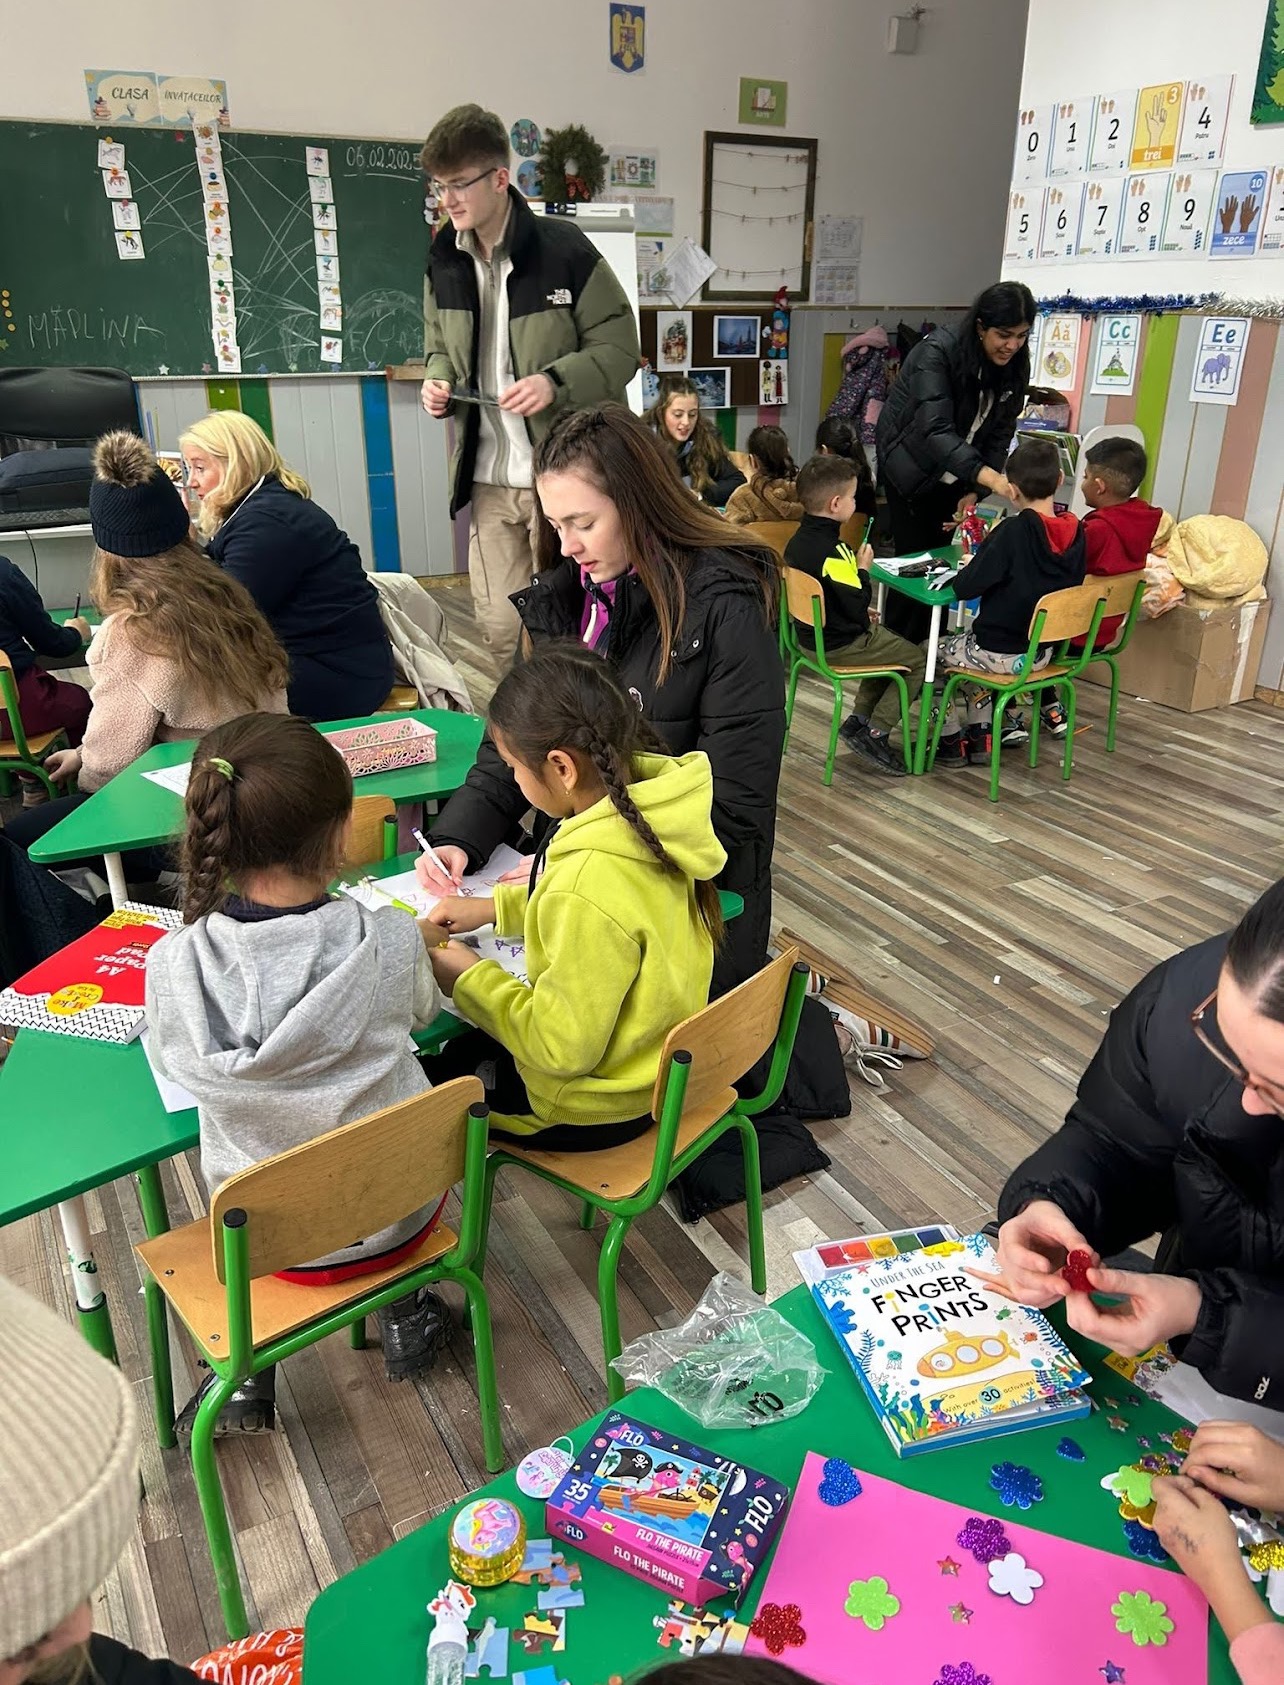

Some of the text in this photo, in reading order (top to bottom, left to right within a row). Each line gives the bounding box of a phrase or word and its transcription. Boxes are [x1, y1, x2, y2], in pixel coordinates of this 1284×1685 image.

[112, 87, 149, 100] CLASA
[1169, 87, 1178, 103] 3
[1198, 106, 1211, 129] 4
[1068, 122, 1077, 143] 1
[1108, 118, 1120, 140] 2
[1028, 132, 1039, 152] 0
[346, 144, 423, 170] 06.02.2025
[1143, 147, 1162, 160] trei
[1251, 178, 1263, 188] 10
[1057, 209, 1067, 229] 6
[1098, 205, 1108, 226] 7
[1138, 201, 1150, 223] 8
[1184, 199, 1196, 221] 9
[1019, 214, 1029, 233] 5
[1223, 235, 1246, 245] zece
[93, 954, 147, 970] Paper
[114, 947, 148, 958] Pad
[95, 964, 127, 976] A4
[870, 1261, 946, 1288] UNDER THE SEA
[945, 1378, 1036, 1413] With over 30 activities!
[620, 1430, 644, 1446] FLO
[564, 1479, 592, 1501] 35
[744, 1495, 773, 1534] FLO
[566, 1525, 584, 1540] FLO
[636, 1528, 704, 1561] FLO THE PIRATE
[613, 1546, 685, 1589] FLO THE PIRATE
